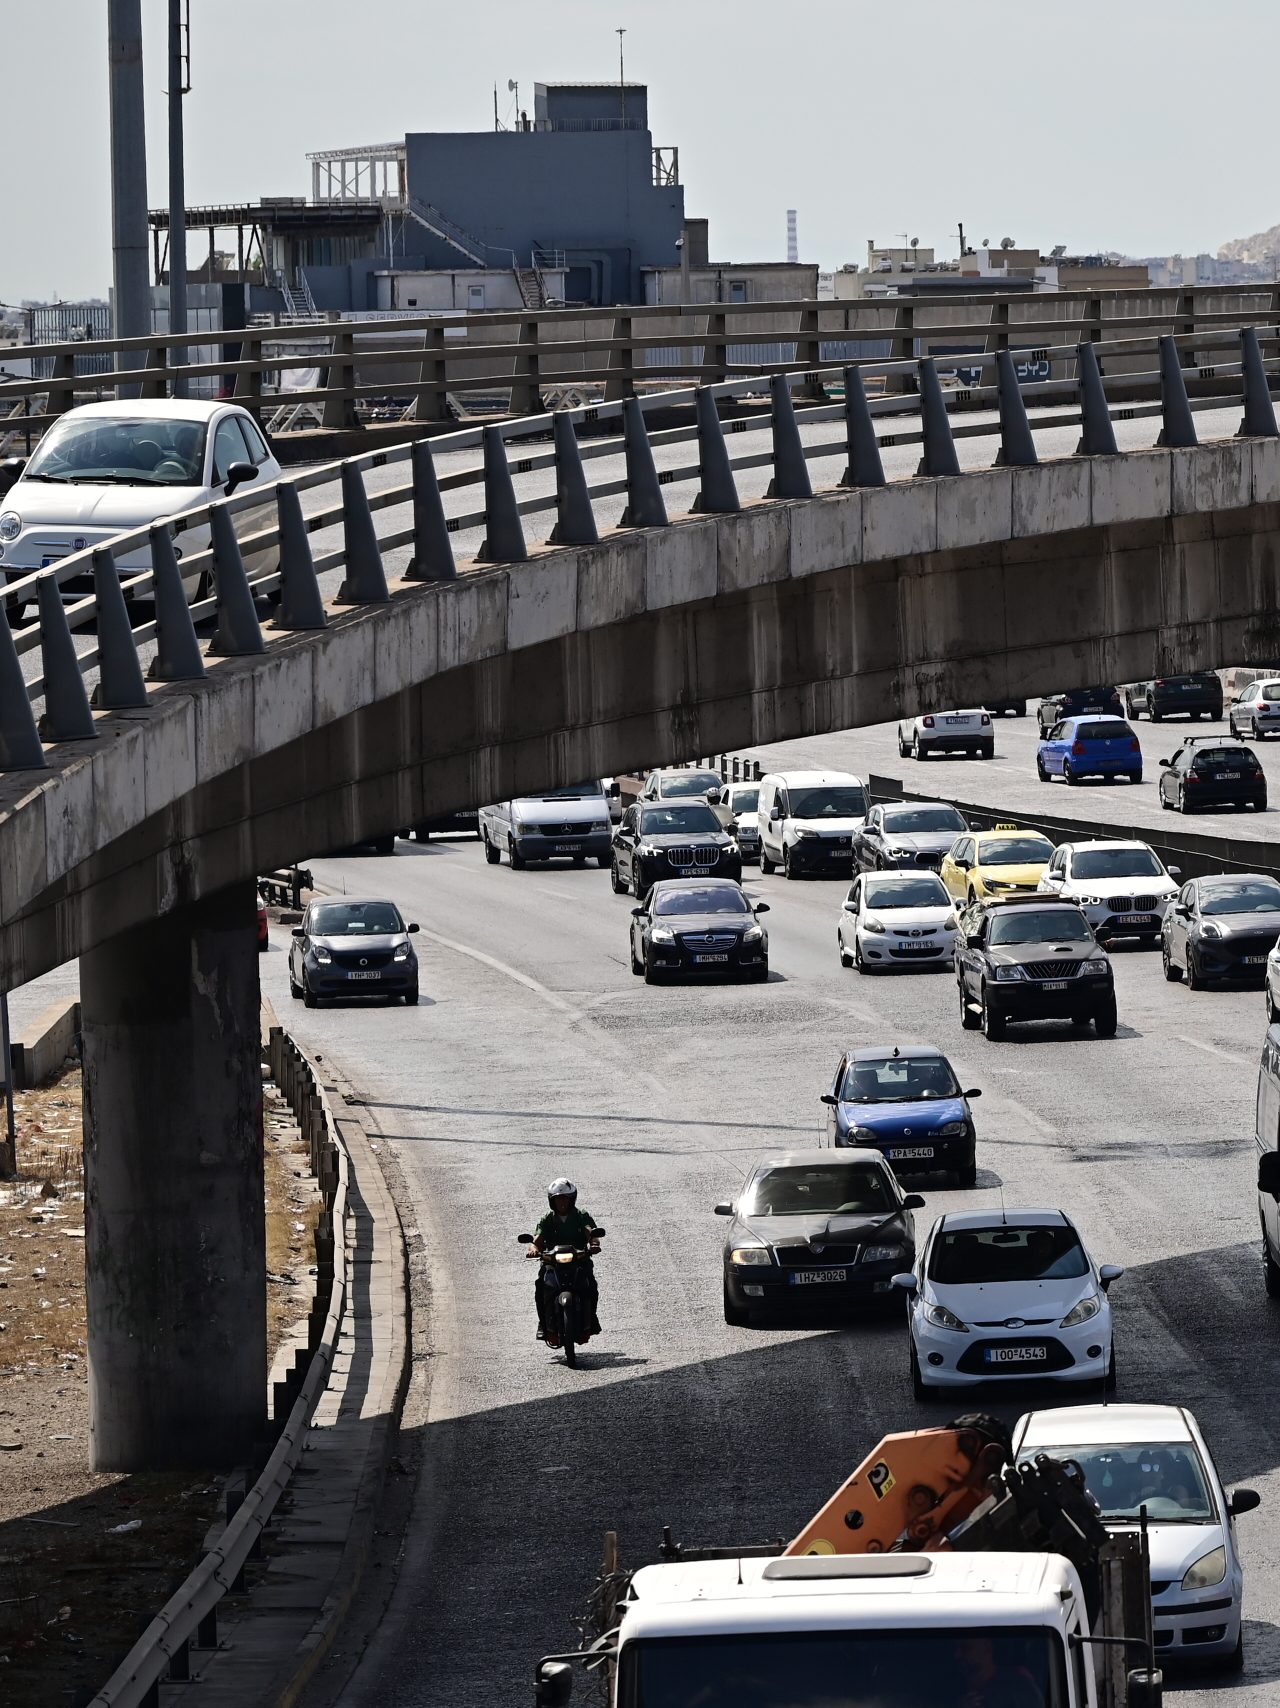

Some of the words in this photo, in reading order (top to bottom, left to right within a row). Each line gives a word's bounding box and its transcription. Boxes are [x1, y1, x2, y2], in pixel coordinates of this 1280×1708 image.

[891, 1148, 934, 1159] XPA-5440
[798, 1270, 846, 1284] IHZ-3026
[993, 1348, 1046, 1362] IOO-4543
